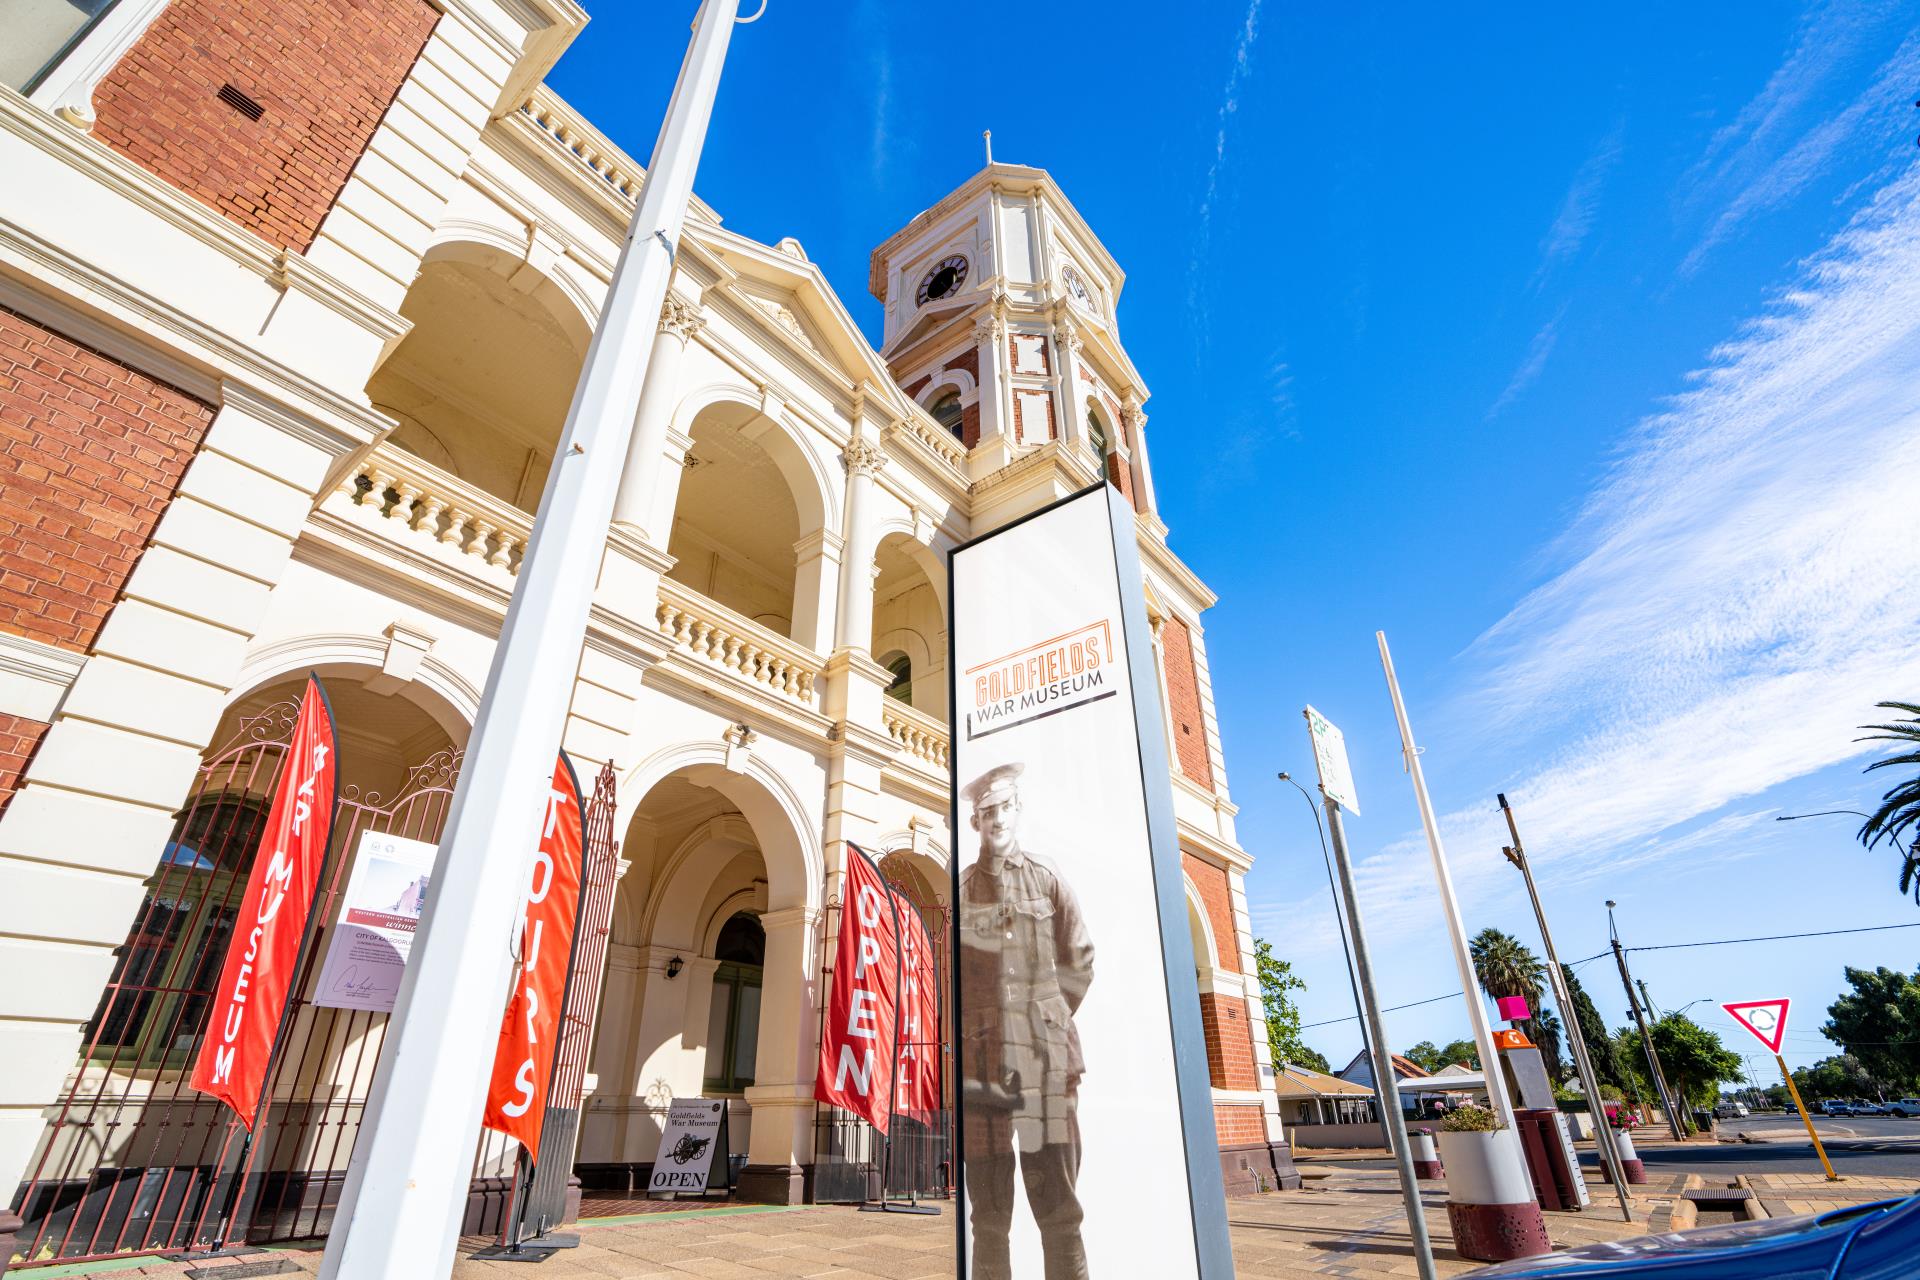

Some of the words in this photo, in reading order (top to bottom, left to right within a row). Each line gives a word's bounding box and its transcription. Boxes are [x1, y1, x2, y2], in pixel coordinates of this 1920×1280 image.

[976, 636, 1100, 707] GOLDFIELDS
[977, 699, 1015, 724] WAR
[1020, 670, 1104, 711] MUSEUM
[355, 932, 370, 940] CITY
[386, 920, 417, 931] winne
[211, 850, 294, 1085] MUSEUM
[834, 884, 882, 1098] OPEN
[898, 1015, 918, 1110] HALL
[671, 1119, 687, 1127] War
[687, 1119, 718, 1127] Museum
[653, 1172, 706, 1187] OPEN
